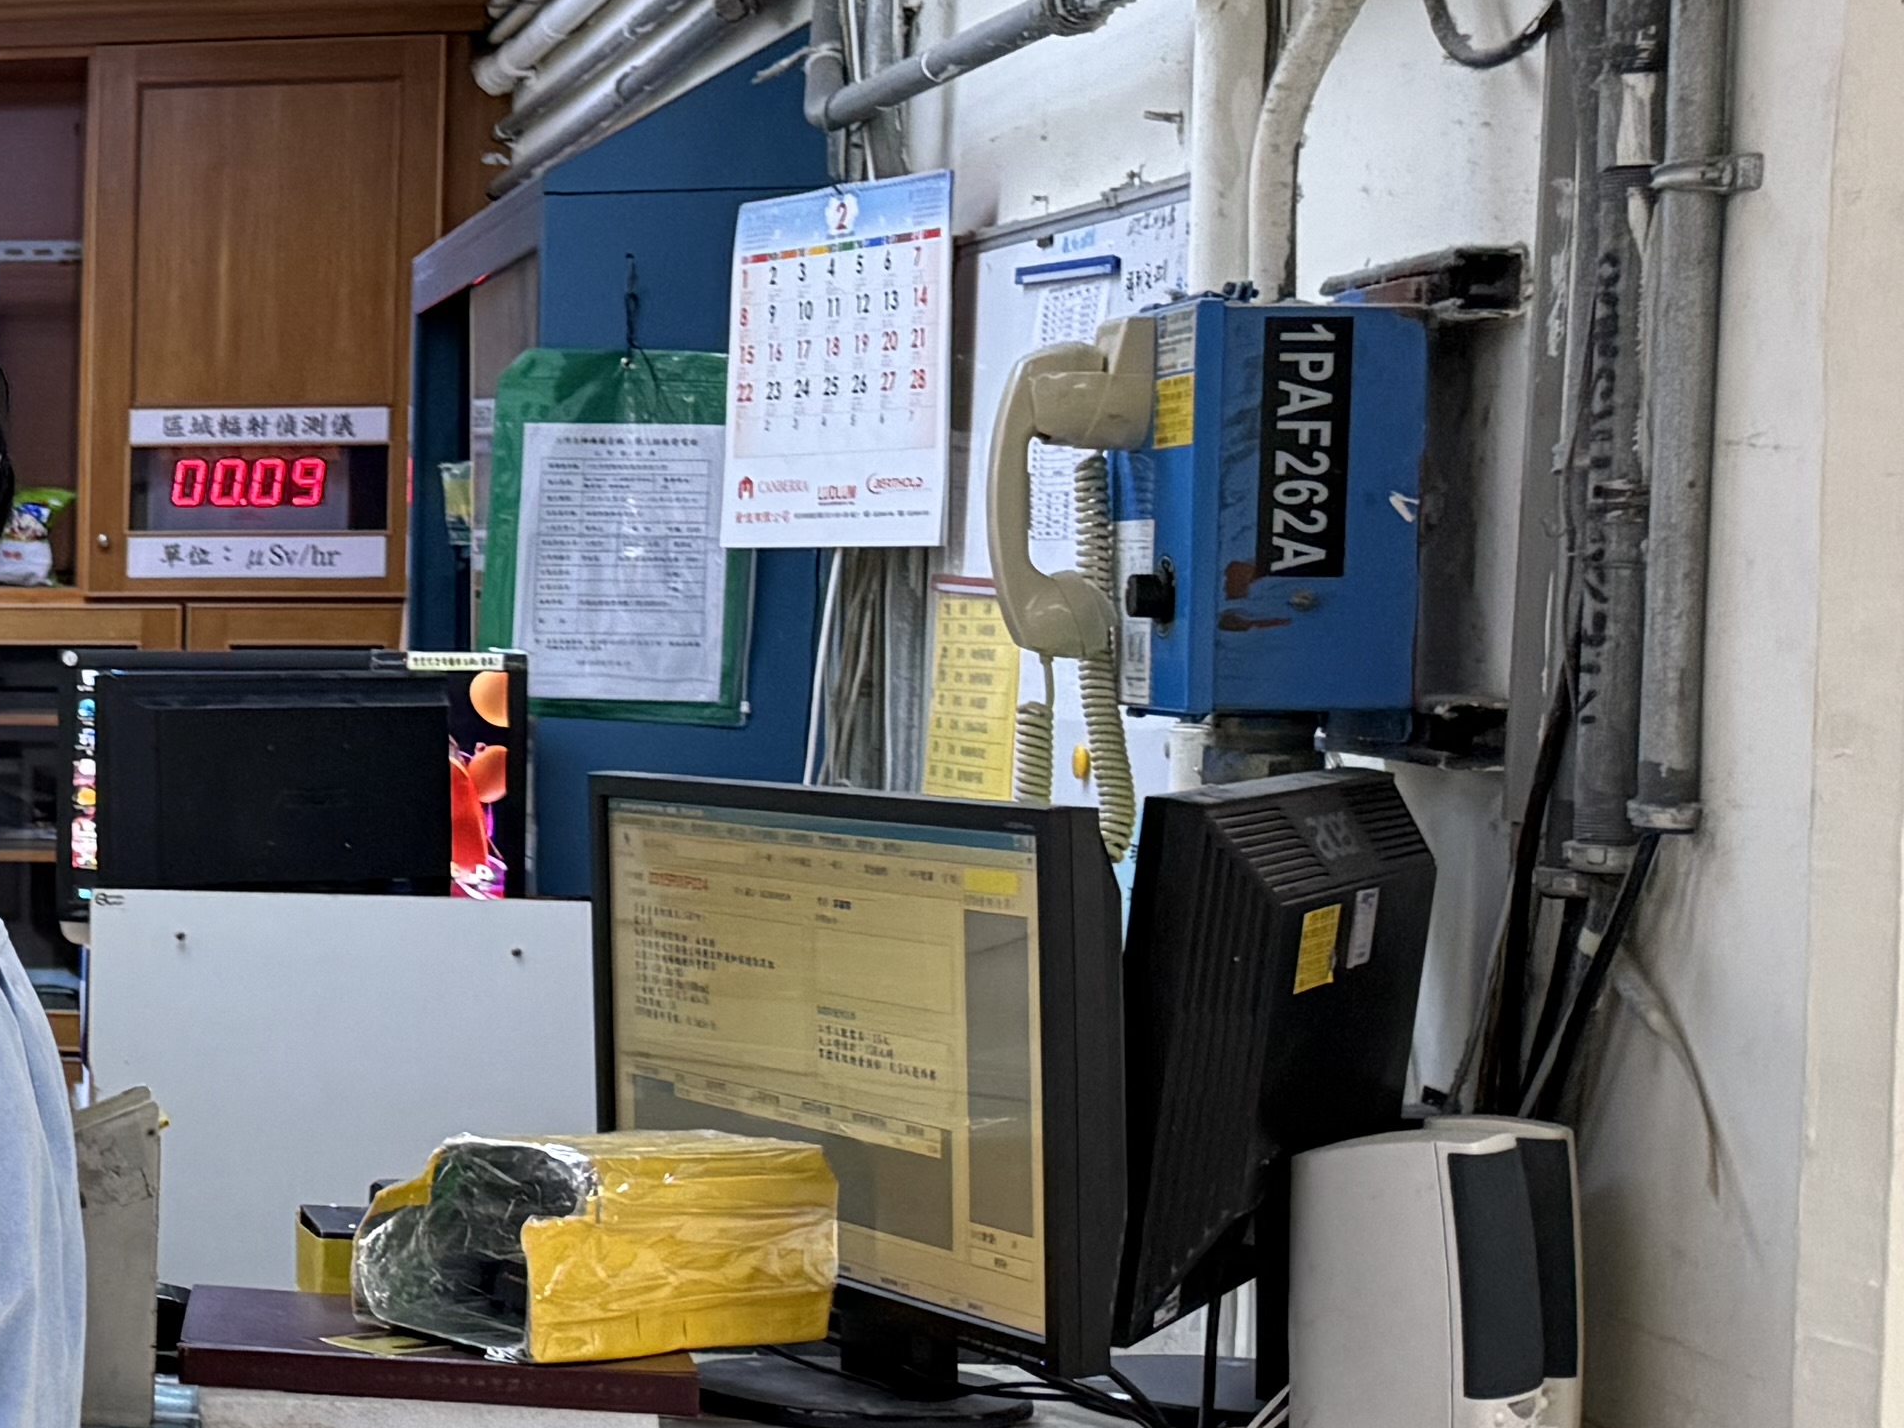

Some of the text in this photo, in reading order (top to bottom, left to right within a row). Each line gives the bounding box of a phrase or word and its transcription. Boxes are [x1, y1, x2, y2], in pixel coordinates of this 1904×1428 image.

[836, 203, 847, 230] 2
[742, 247, 921, 288] 1 2 3 4 5 6 7
[740, 286, 928, 326] 8 9 10 11 12 13 14
[740, 328, 925, 364] 15 16 17 18 19 20 21
[737, 369, 926, 402] 22 23 24 25 26 27 28
[162, 413, 356, 438] 區域輻射偵測儀
[1271, 323, 1336, 572] 1PAF262A
